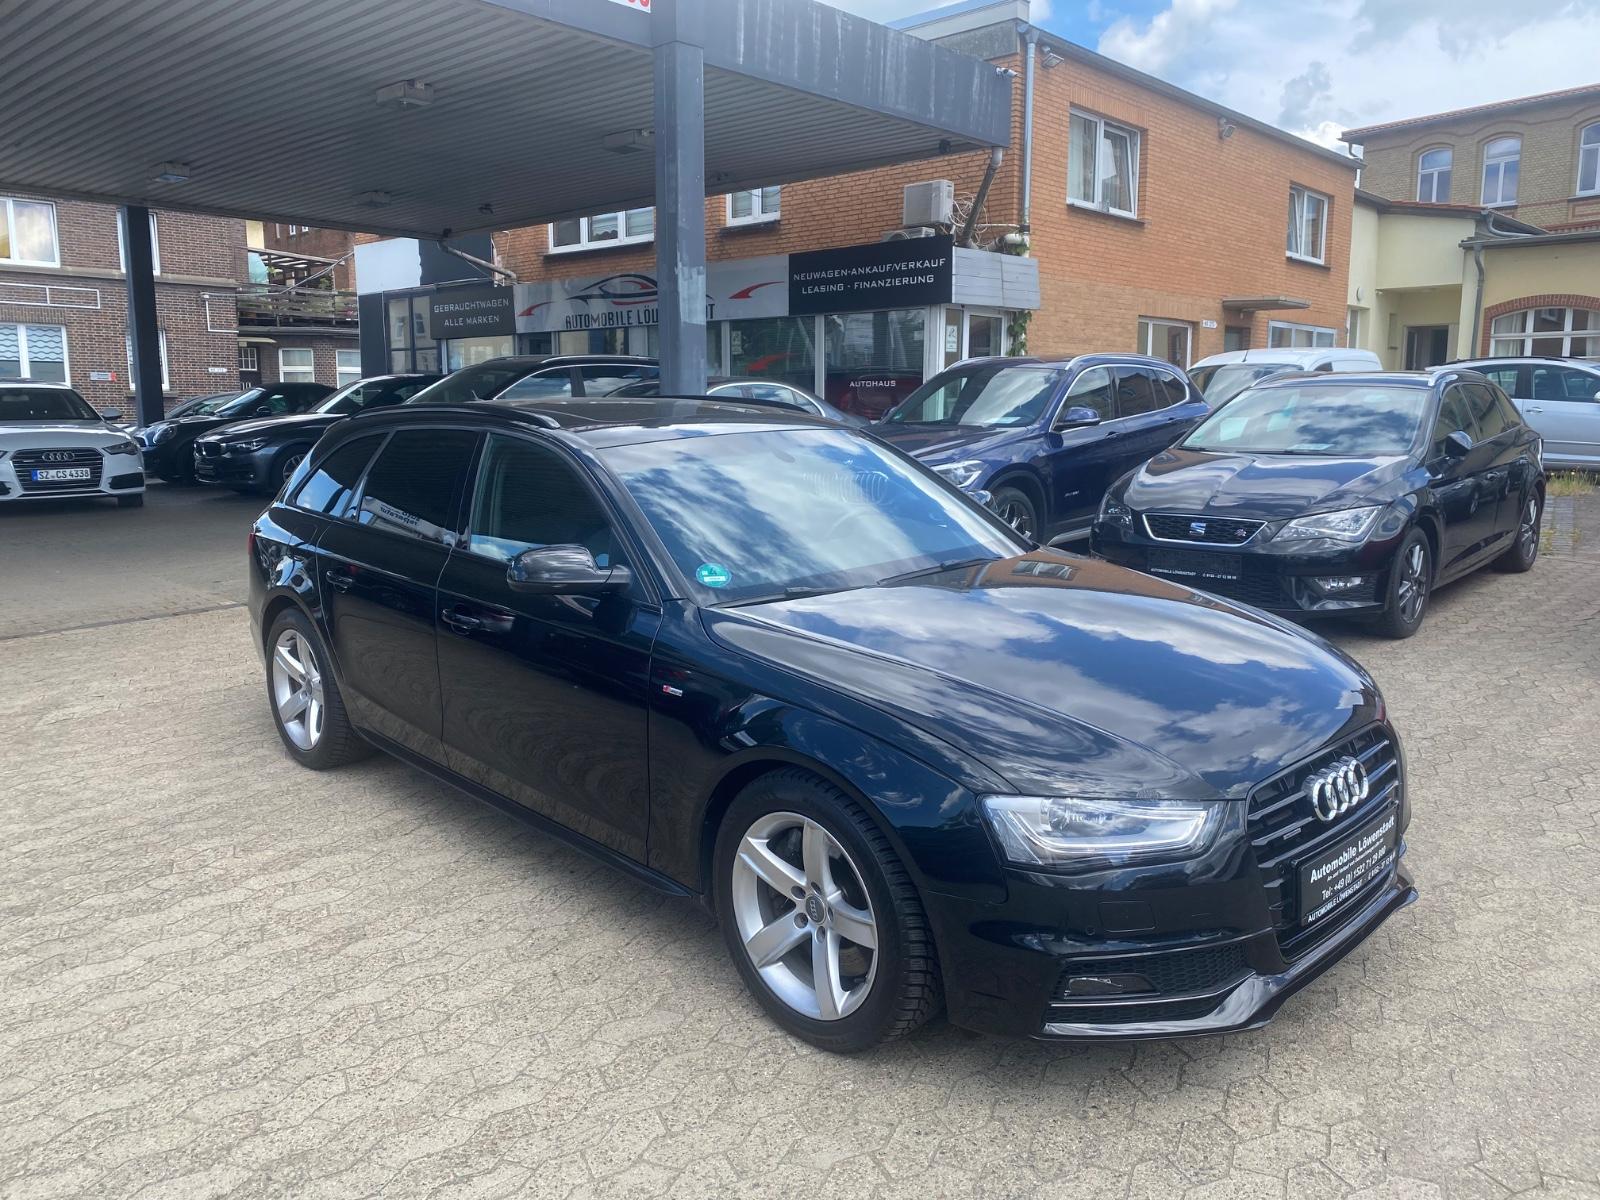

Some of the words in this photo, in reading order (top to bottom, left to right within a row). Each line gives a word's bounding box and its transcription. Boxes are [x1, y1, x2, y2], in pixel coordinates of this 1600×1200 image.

[802, 283, 844, 294] LEASING
[854, 275, 935, 289] FINANZIERUNG
[434, 299, 509, 312] GEBRAUCHTWAGEN
[444, 318, 464, 326] ALLE
[466, 315, 500, 325] MARKEN
[565, 309, 633, 329] AUTOMOBILE
[39, 471, 49, 479] SZ
[69, 470, 89, 478] 4338
[1311, 846, 1356, 883] Automobile
[1359, 815, 1394, 852] Löwenstadt
[1308, 898, 1337, 922] AUTOMOBILE
